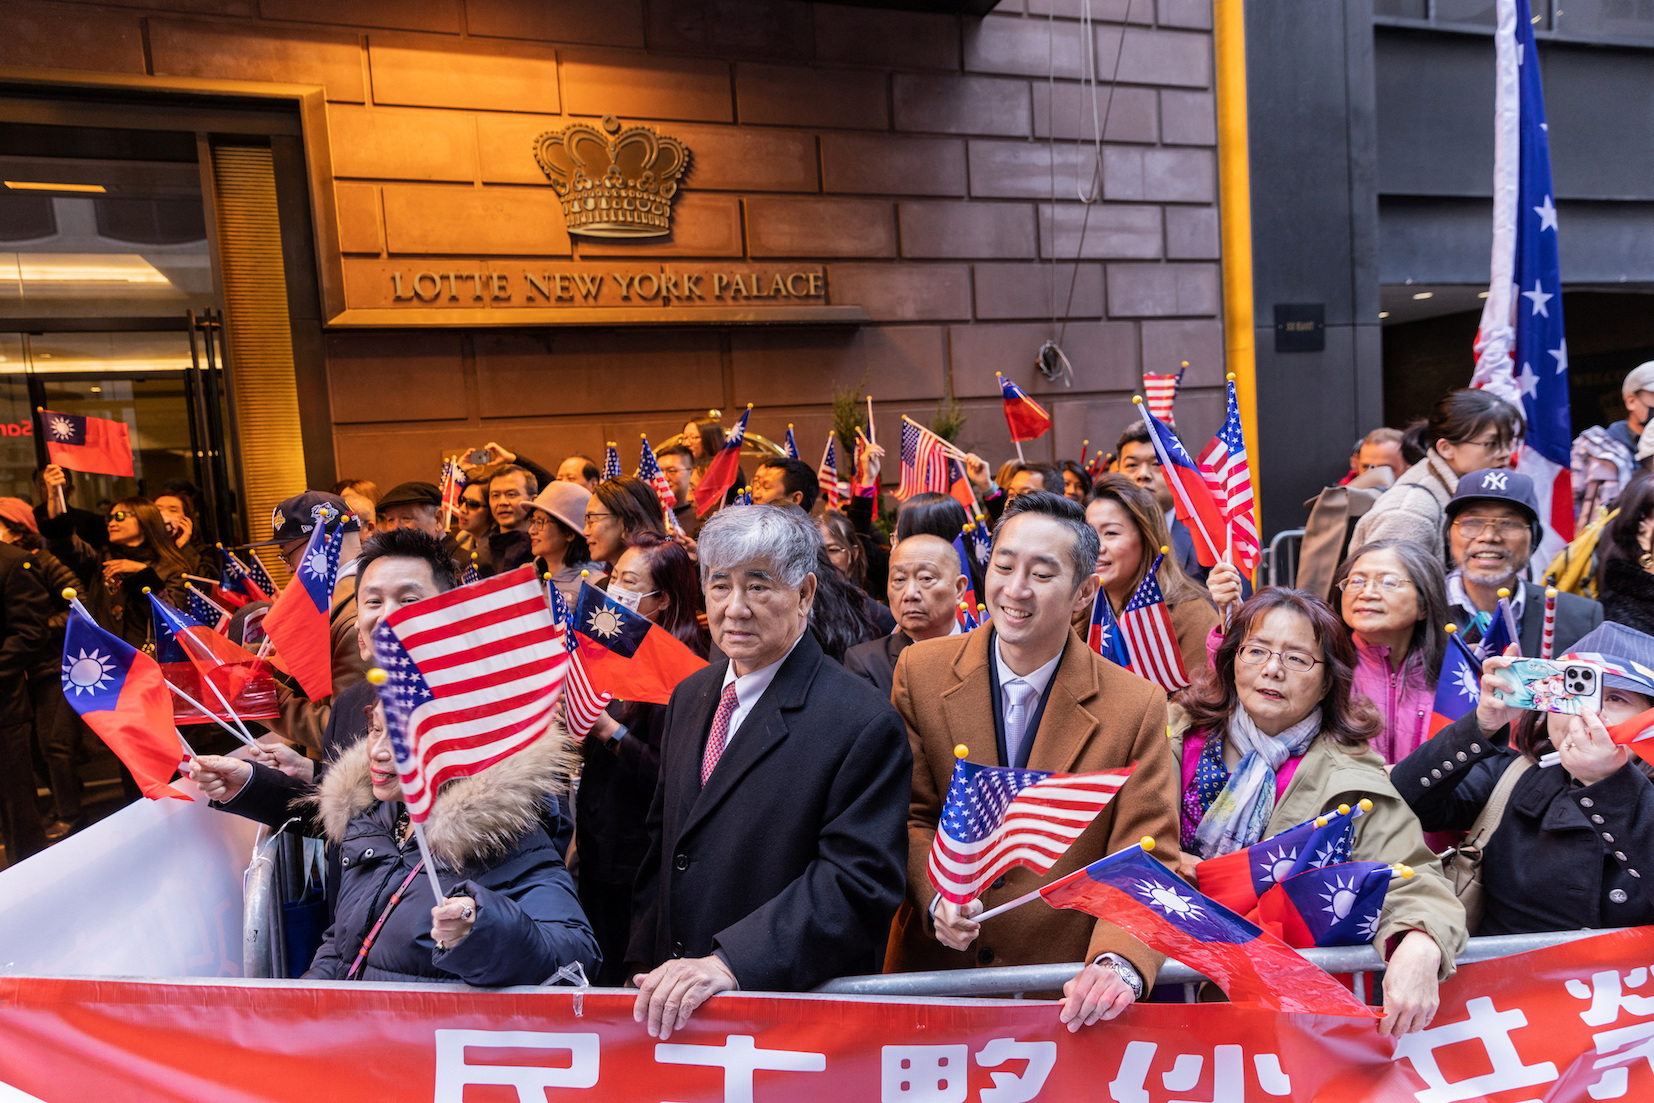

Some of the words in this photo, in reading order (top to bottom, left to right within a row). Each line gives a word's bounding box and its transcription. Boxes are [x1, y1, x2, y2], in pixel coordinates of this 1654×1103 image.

[391, 271, 510, 301] LOTTE
[525, 272, 604, 301] NEW
[613, 272, 704, 301] YORK
[711, 271, 825, 299] PALACE
